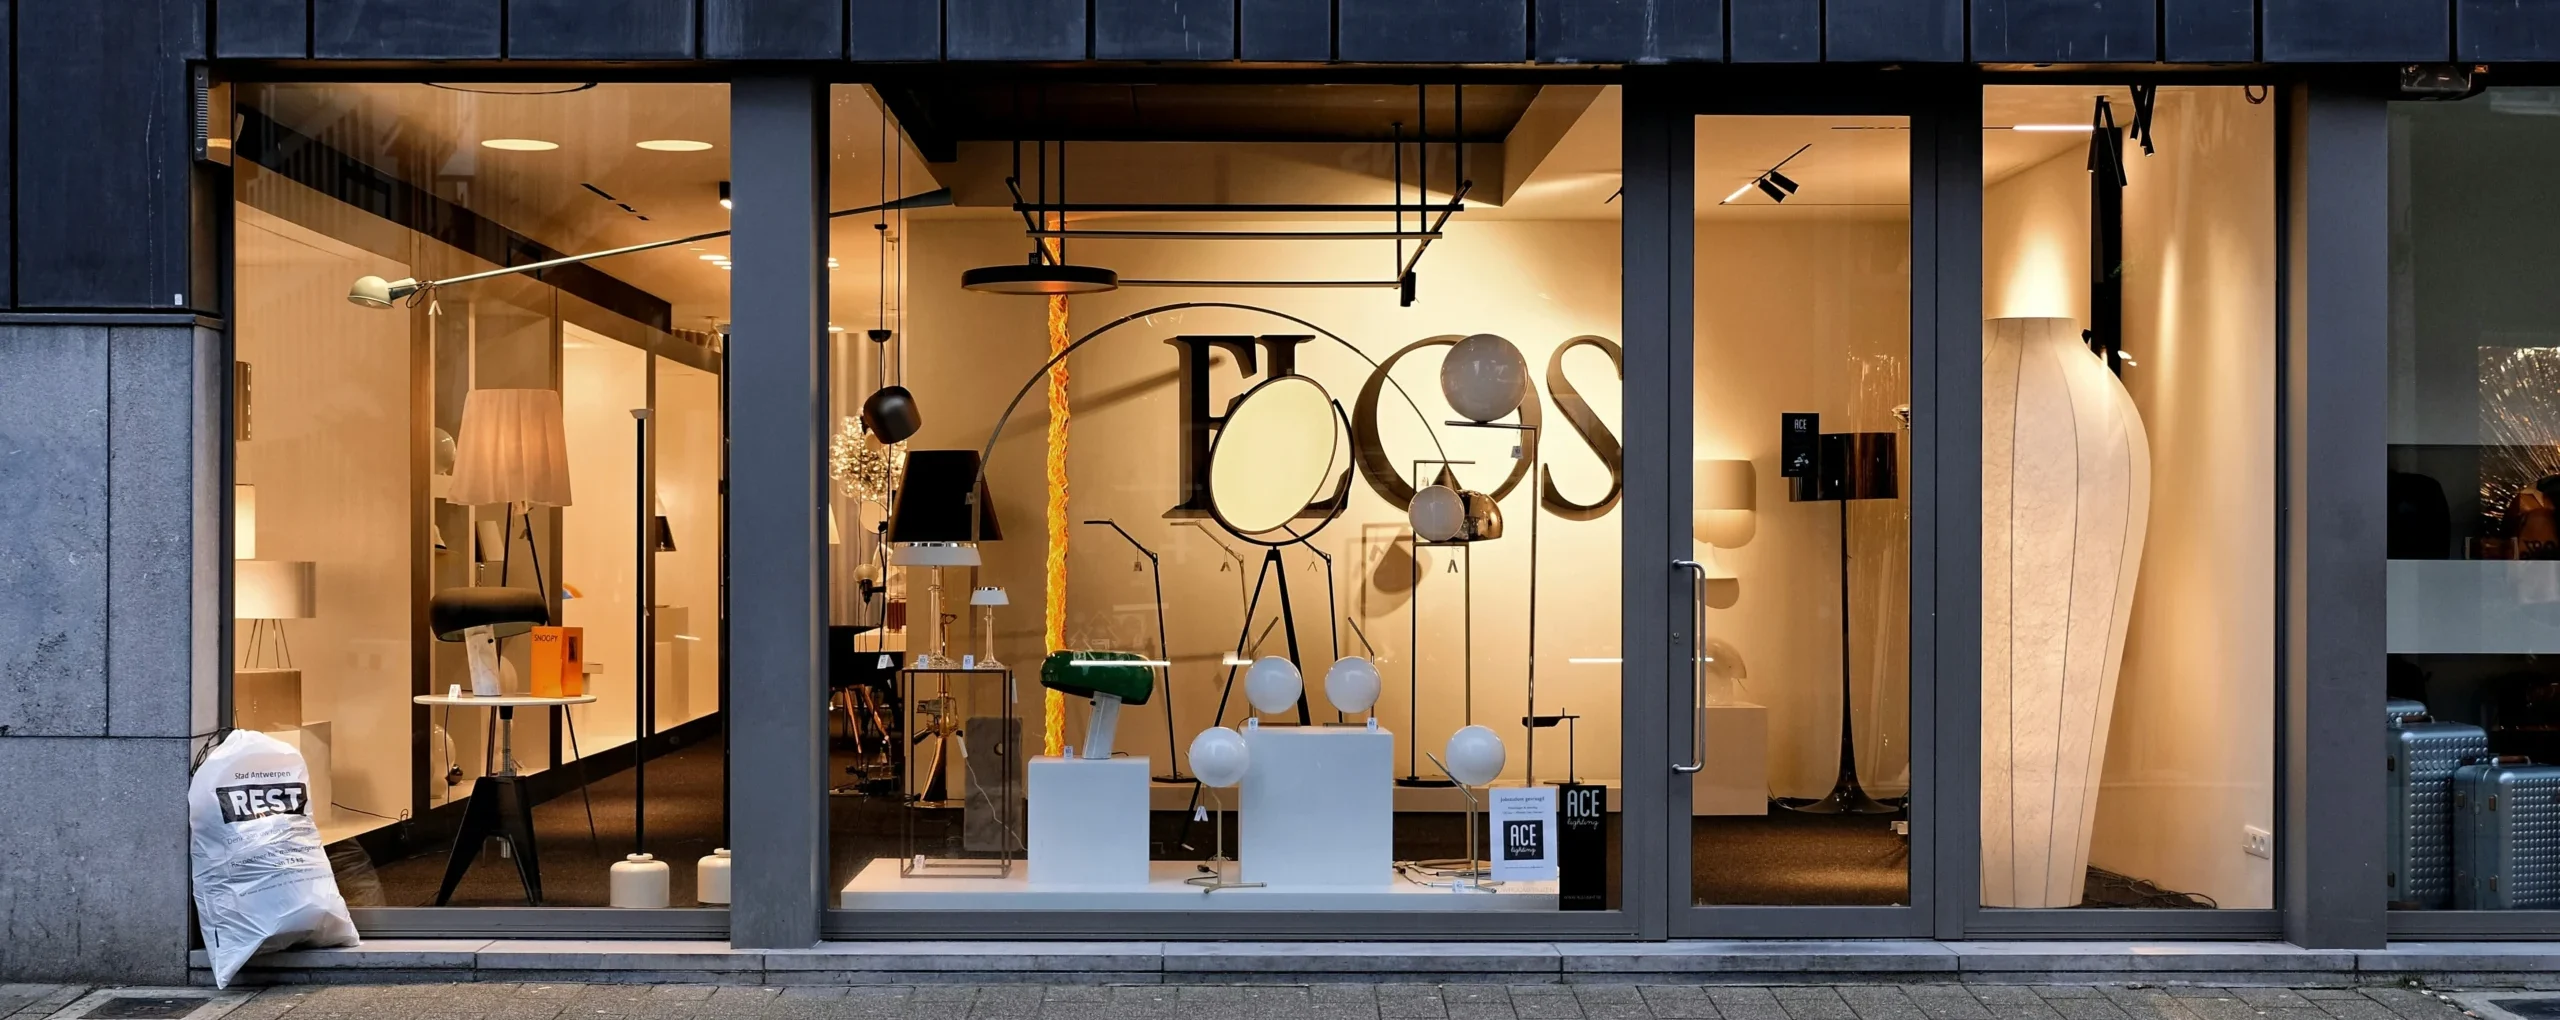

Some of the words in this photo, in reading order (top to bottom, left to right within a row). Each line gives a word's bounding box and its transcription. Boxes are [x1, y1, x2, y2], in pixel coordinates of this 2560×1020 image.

[1794, 418, 1807, 430] ACE
[234, 772, 249, 780] Stad
[250, 771, 291, 780] Antwerpen
[228, 787, 302, 817] REST
[1567, 789, 1600, 818] ACE
[1567, 818, 1598, 830] lighting
[1510, 824, 1536, 846] ACE
[1511, 846, 1536, 856] lighting
